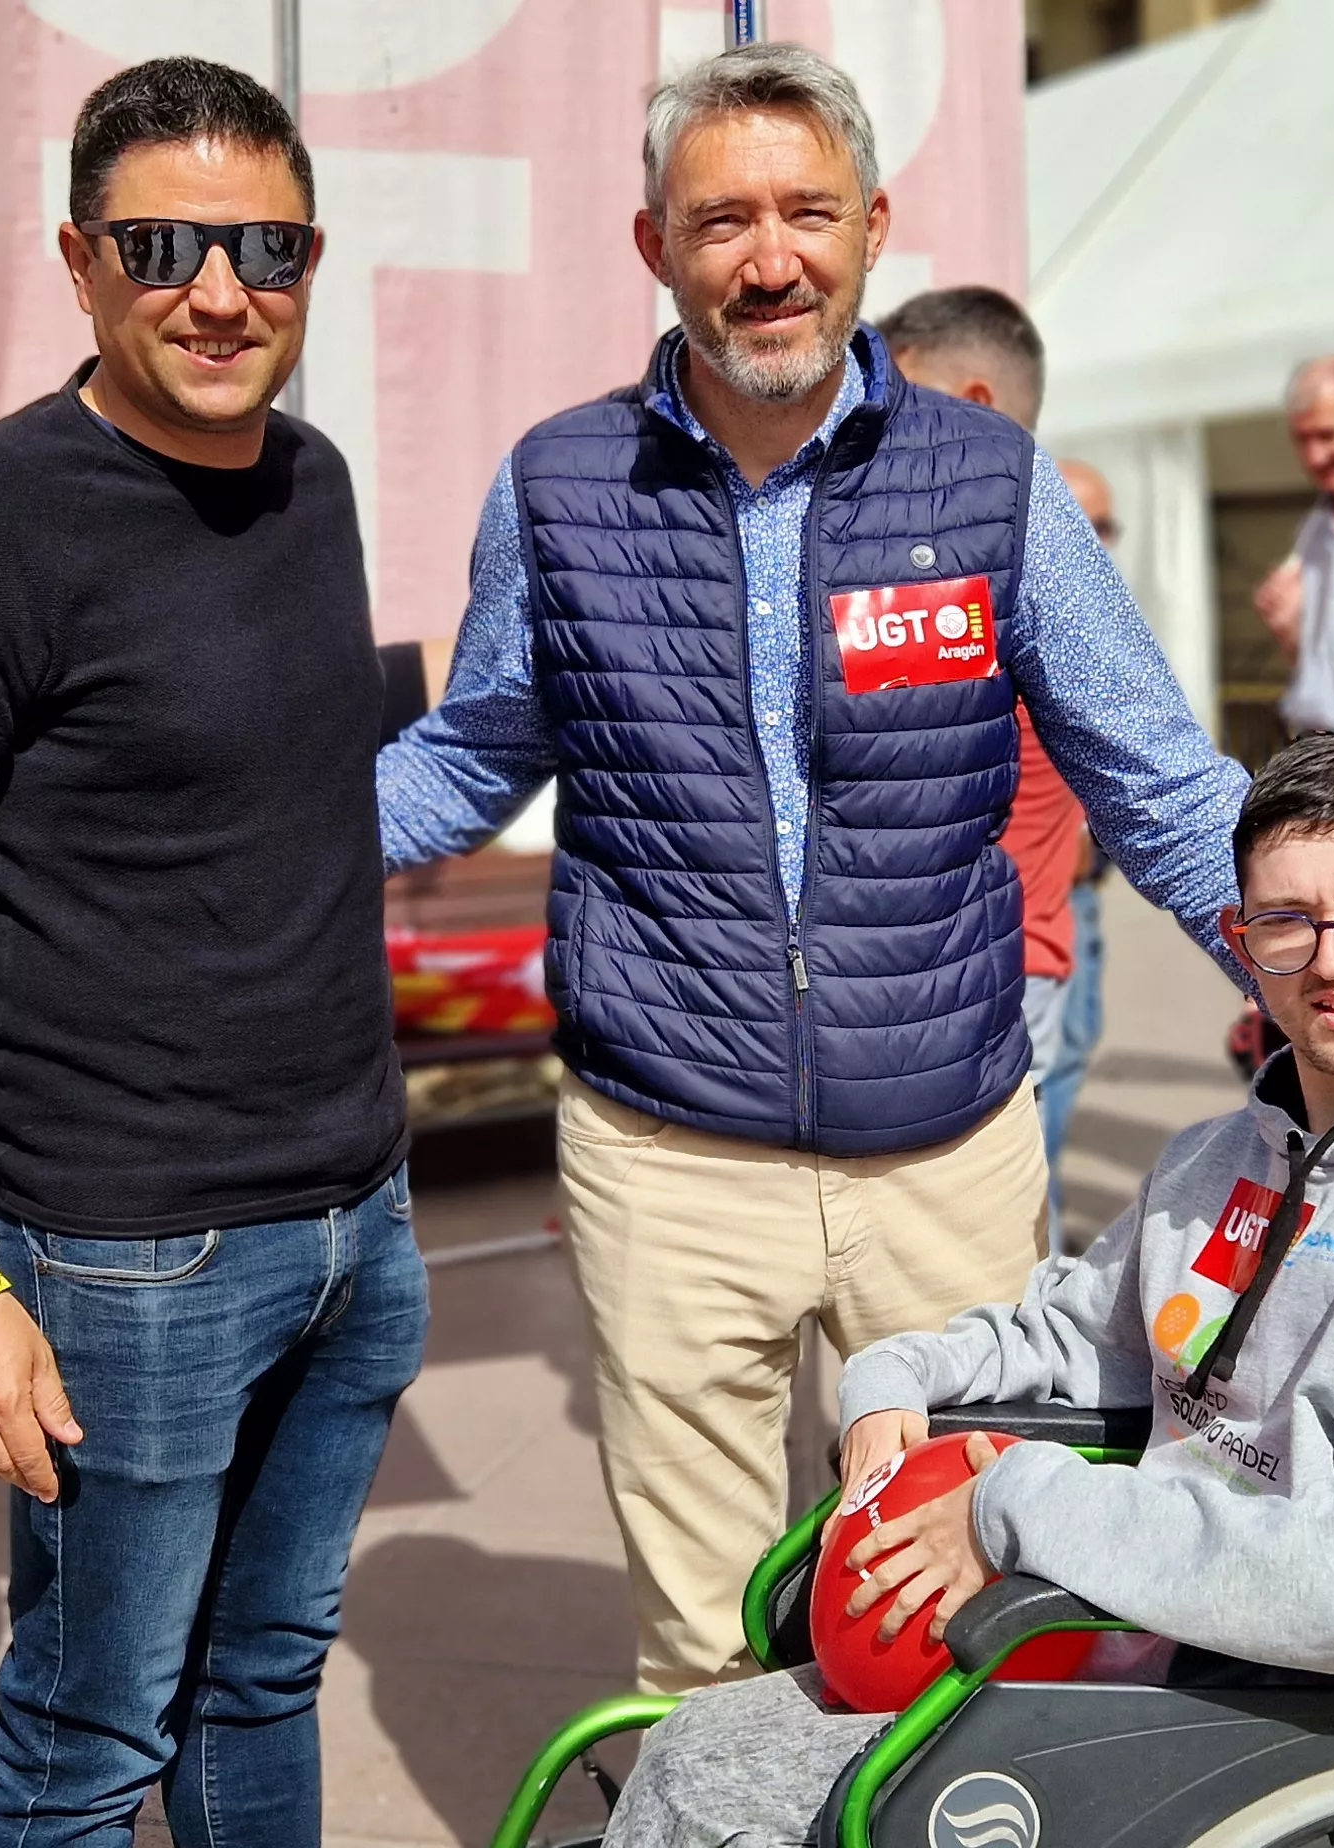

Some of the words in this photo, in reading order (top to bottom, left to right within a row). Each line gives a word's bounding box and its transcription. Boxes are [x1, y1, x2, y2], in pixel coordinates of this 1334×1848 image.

[848, 609, 929, 652] UGT
[938, 641, 985, 661] Aragón
[1224, 1206, 1270, 1252] UGT
[1219, 1432, 1280, 1481] PÁDEL
